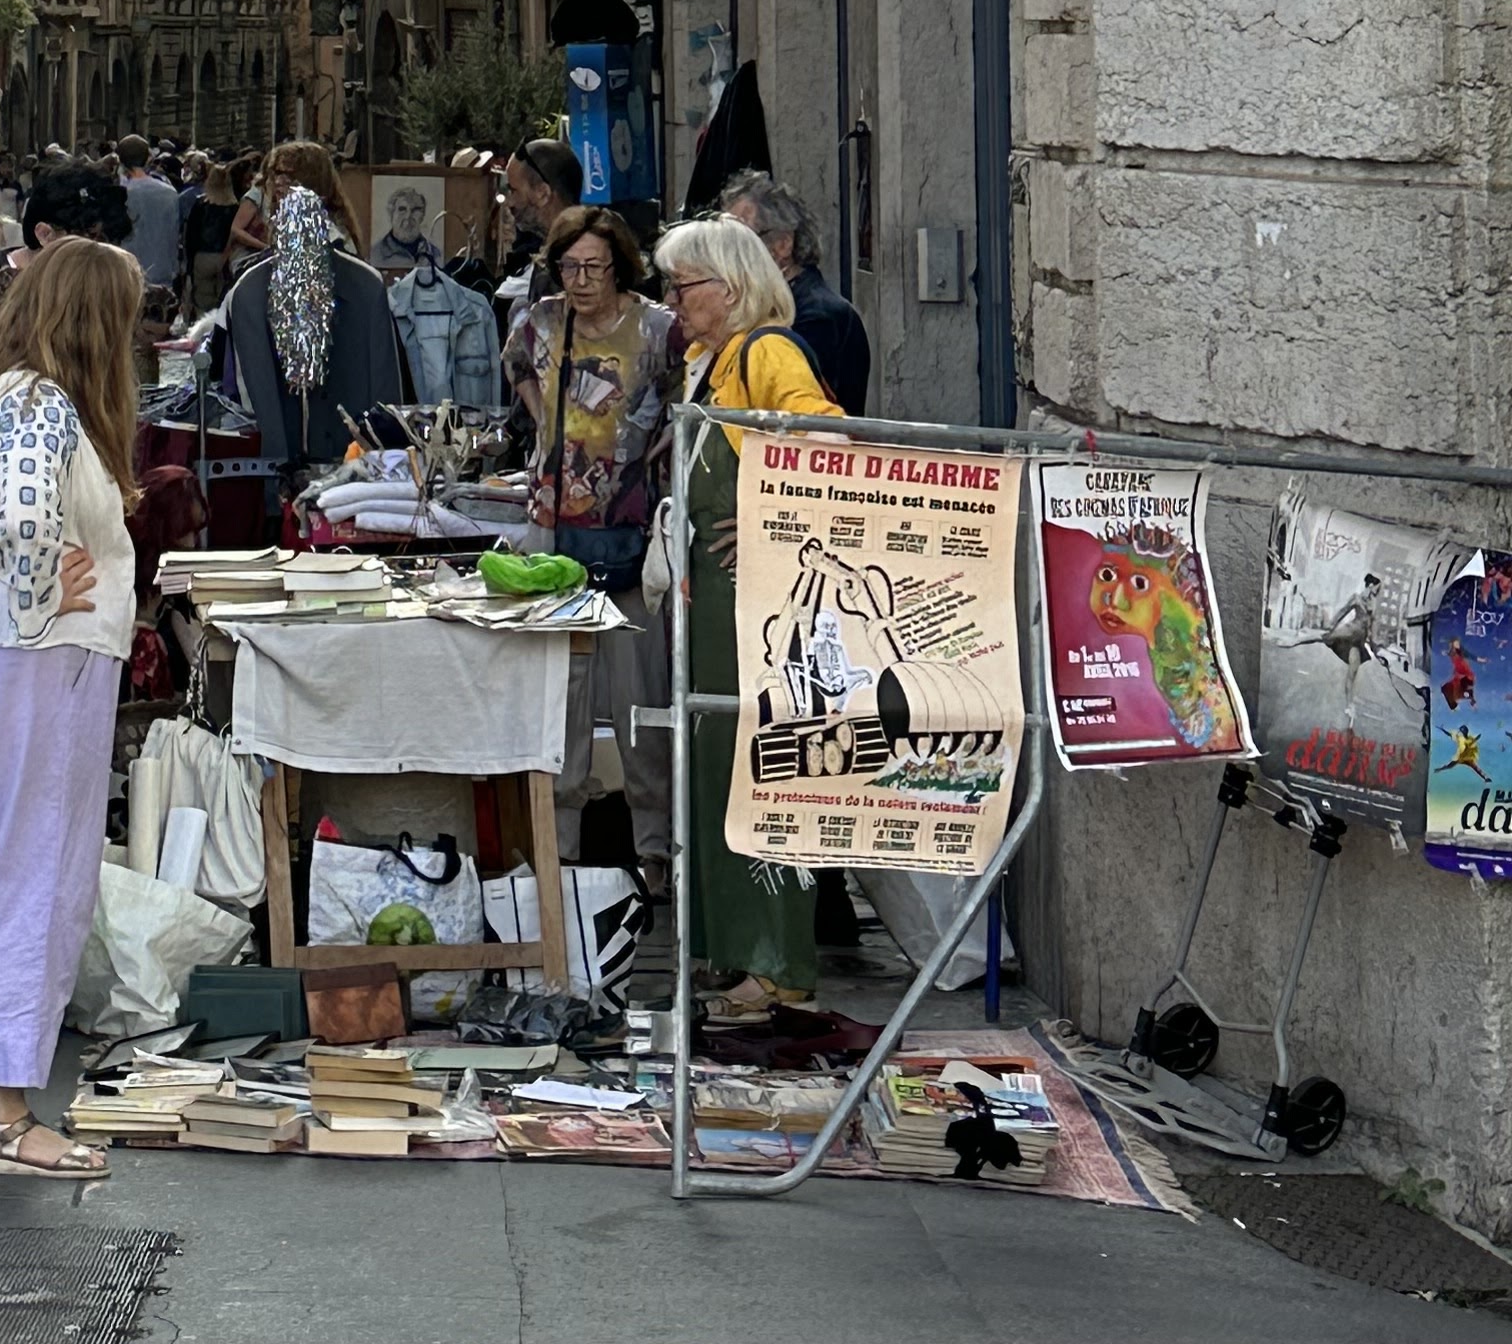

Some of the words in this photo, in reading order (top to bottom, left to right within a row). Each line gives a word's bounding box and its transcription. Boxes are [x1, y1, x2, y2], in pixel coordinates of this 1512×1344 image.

[764, 444, 801, 471] UN
[809, 449, 856, 477] CRI
[864, 455, 1001, 491] D'ALARME
[828, 485, 897, 506] française
[902, 495, 924, 509] est
